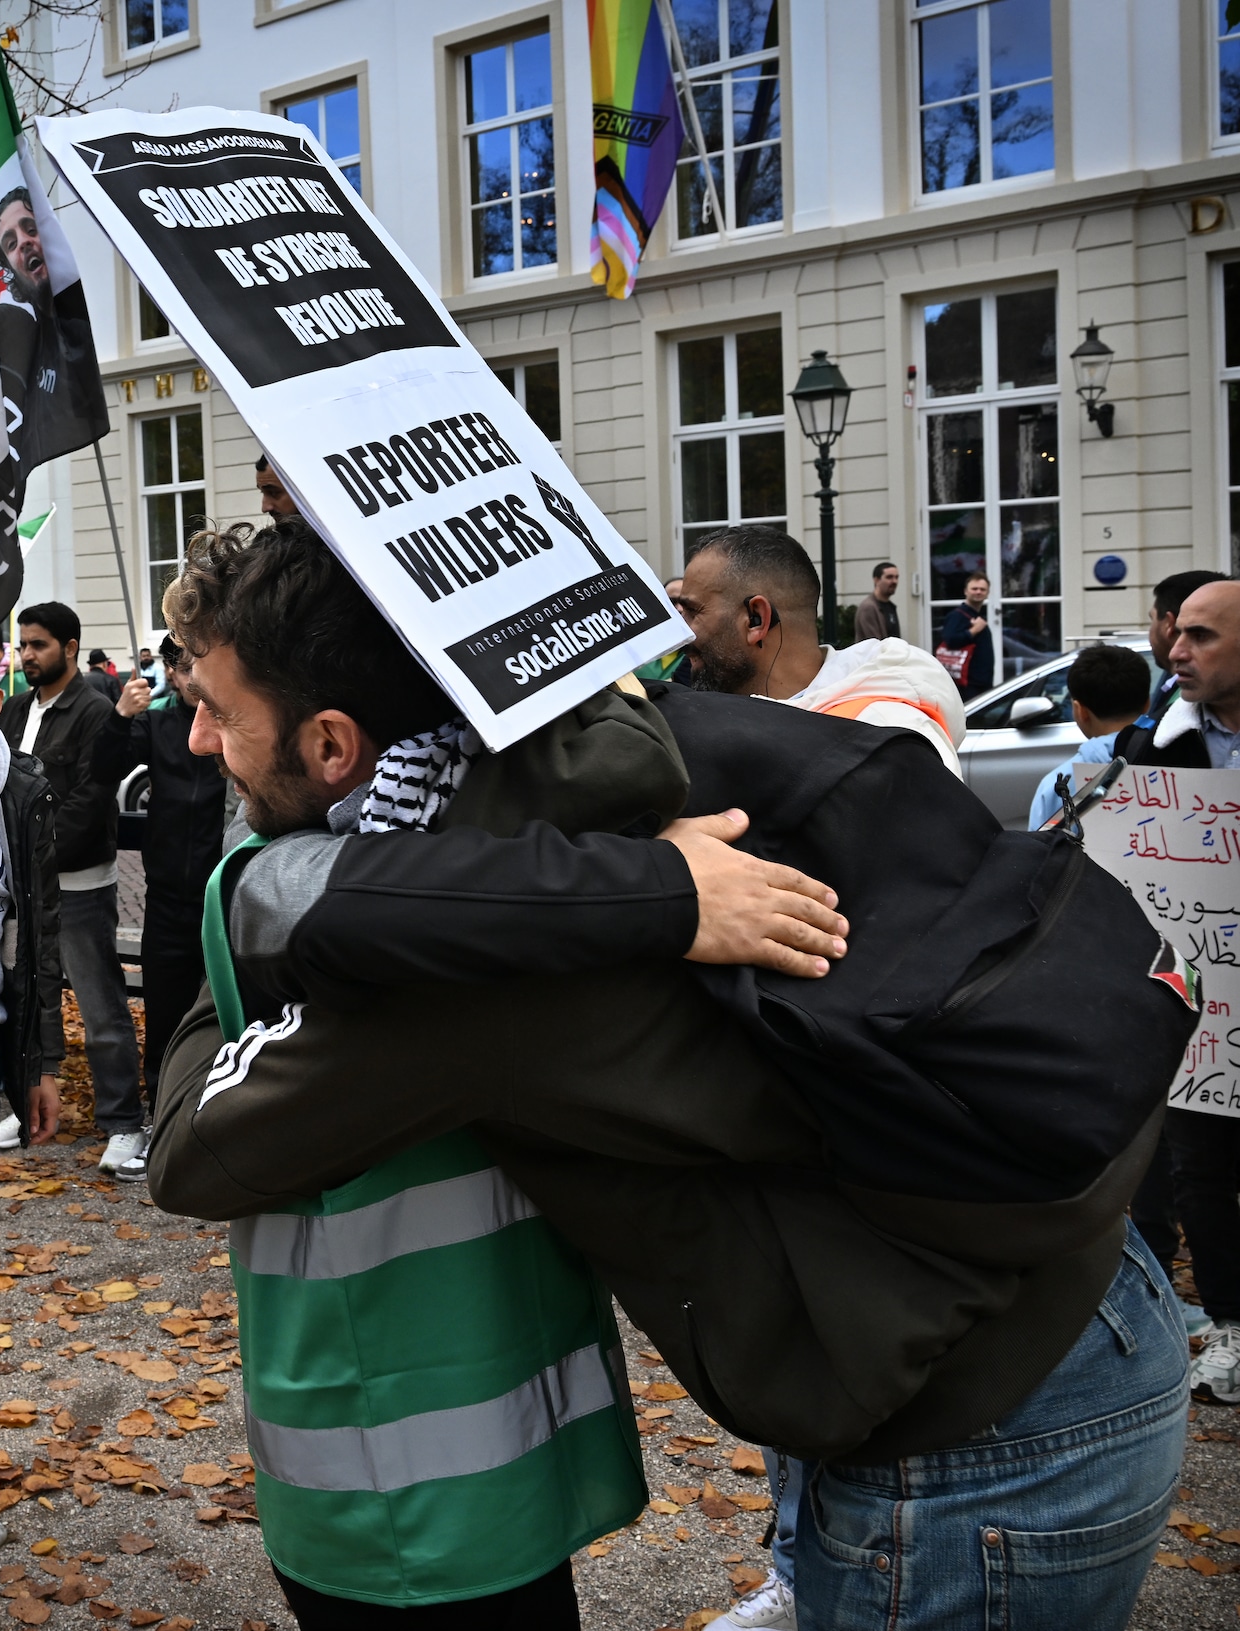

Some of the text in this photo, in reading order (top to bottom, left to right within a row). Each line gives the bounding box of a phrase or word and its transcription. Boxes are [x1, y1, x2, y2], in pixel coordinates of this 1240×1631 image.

[131, 134, 289, 157] ASSAD MASSAMOORDENAAR
[138, 175, 344, 229] SOLIDARITEIT MET
[214, 232, 372, 289] DE SYRISCHE
[274, 288, 406, 346] REVOLUTIE
[322, 412, 522, 518] DEPORTEER
[385, 493, 554, 603] WILDERS
[1103, 526, 1113, 540] 5
[466, 571, 630, 657] Internationale Socialisten
[1202, 1000, 1230, 1018] an
